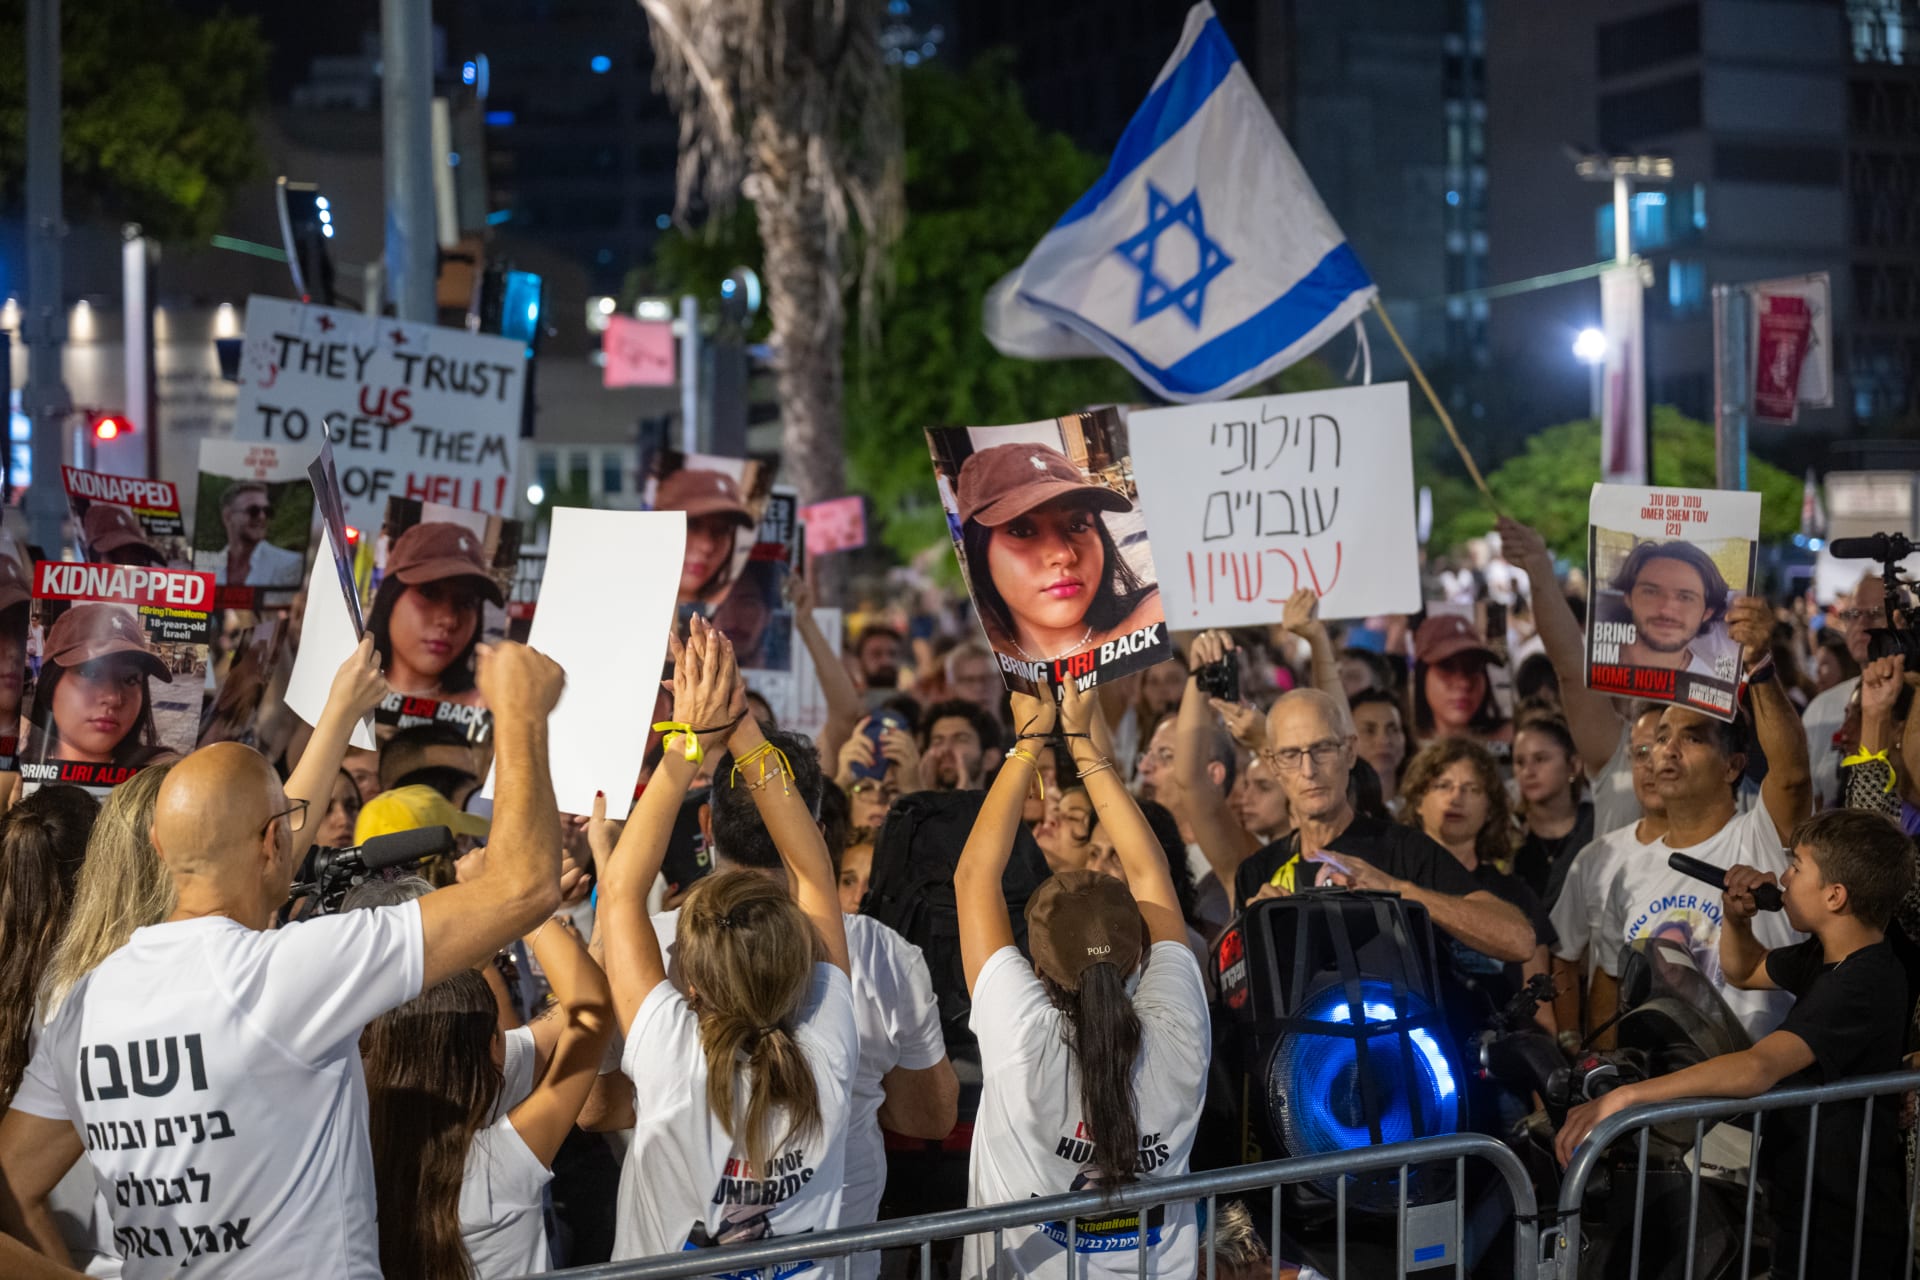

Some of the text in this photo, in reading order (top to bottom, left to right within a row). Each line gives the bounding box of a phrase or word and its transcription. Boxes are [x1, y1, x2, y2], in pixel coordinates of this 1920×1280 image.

[273, 333, 515, 401] THEY TRUST
[359, 385, 413, 425] US
[257, 404, 512, 473] TO GET THEM
[1210, 404, 1342, 476] חילופי
[66, 468, 173, 507] KIDNAPPED
[343, 466, 394, 503] OF
[1203, 486, 1340, 542] שבויים
[1641, 507, 1709, 523] OMER SHEM TOV
[1665, 522, 1682, 537] (21)
[42, 565, 206, 605] KIDNAPPED
[1187, 541, 1342, 617] עכשיו!
[139, 605, 208, 620] #BringThemHome
[150, 618, 206, 632] 18-years-old
[163, 629, 191, 640] Israeli
[1593, 621, 1637, 645] BRING
[999, 623, 1161, 683] BRING LIRI BACK
[1592, 643, 1620, 665] HIM
[1057, 670, 1098, 701] NW!
[1591, 664, 1631, 686] HOME
[1634, 667, 1676, 694] NOW!
[435, 701, 487, 726] BACK
[61, 764, 91, 782] LIRI
[1627, 895, 1722, 941] ING OMER HO
[1087, 944, 1111, 956] POLO
[80, 1033, 208, 1102] ושבו
[86, 1110, 236, 1151] בנים ובנות
[1142, 1132, 1161, 1148] OF
[724, 1157, 741, 1178] RI
[785, 1149, 804, 1171] OF
[1056, 1136, 1170, 1173] HUDS
[115, 1167, 211, 1208] לגבולם
[711, 1167, 814, 1206] UNDREDS
[180, 1217, 252, 1267] אמן
[1077, 1216, 1140, 1233] ThemHome
